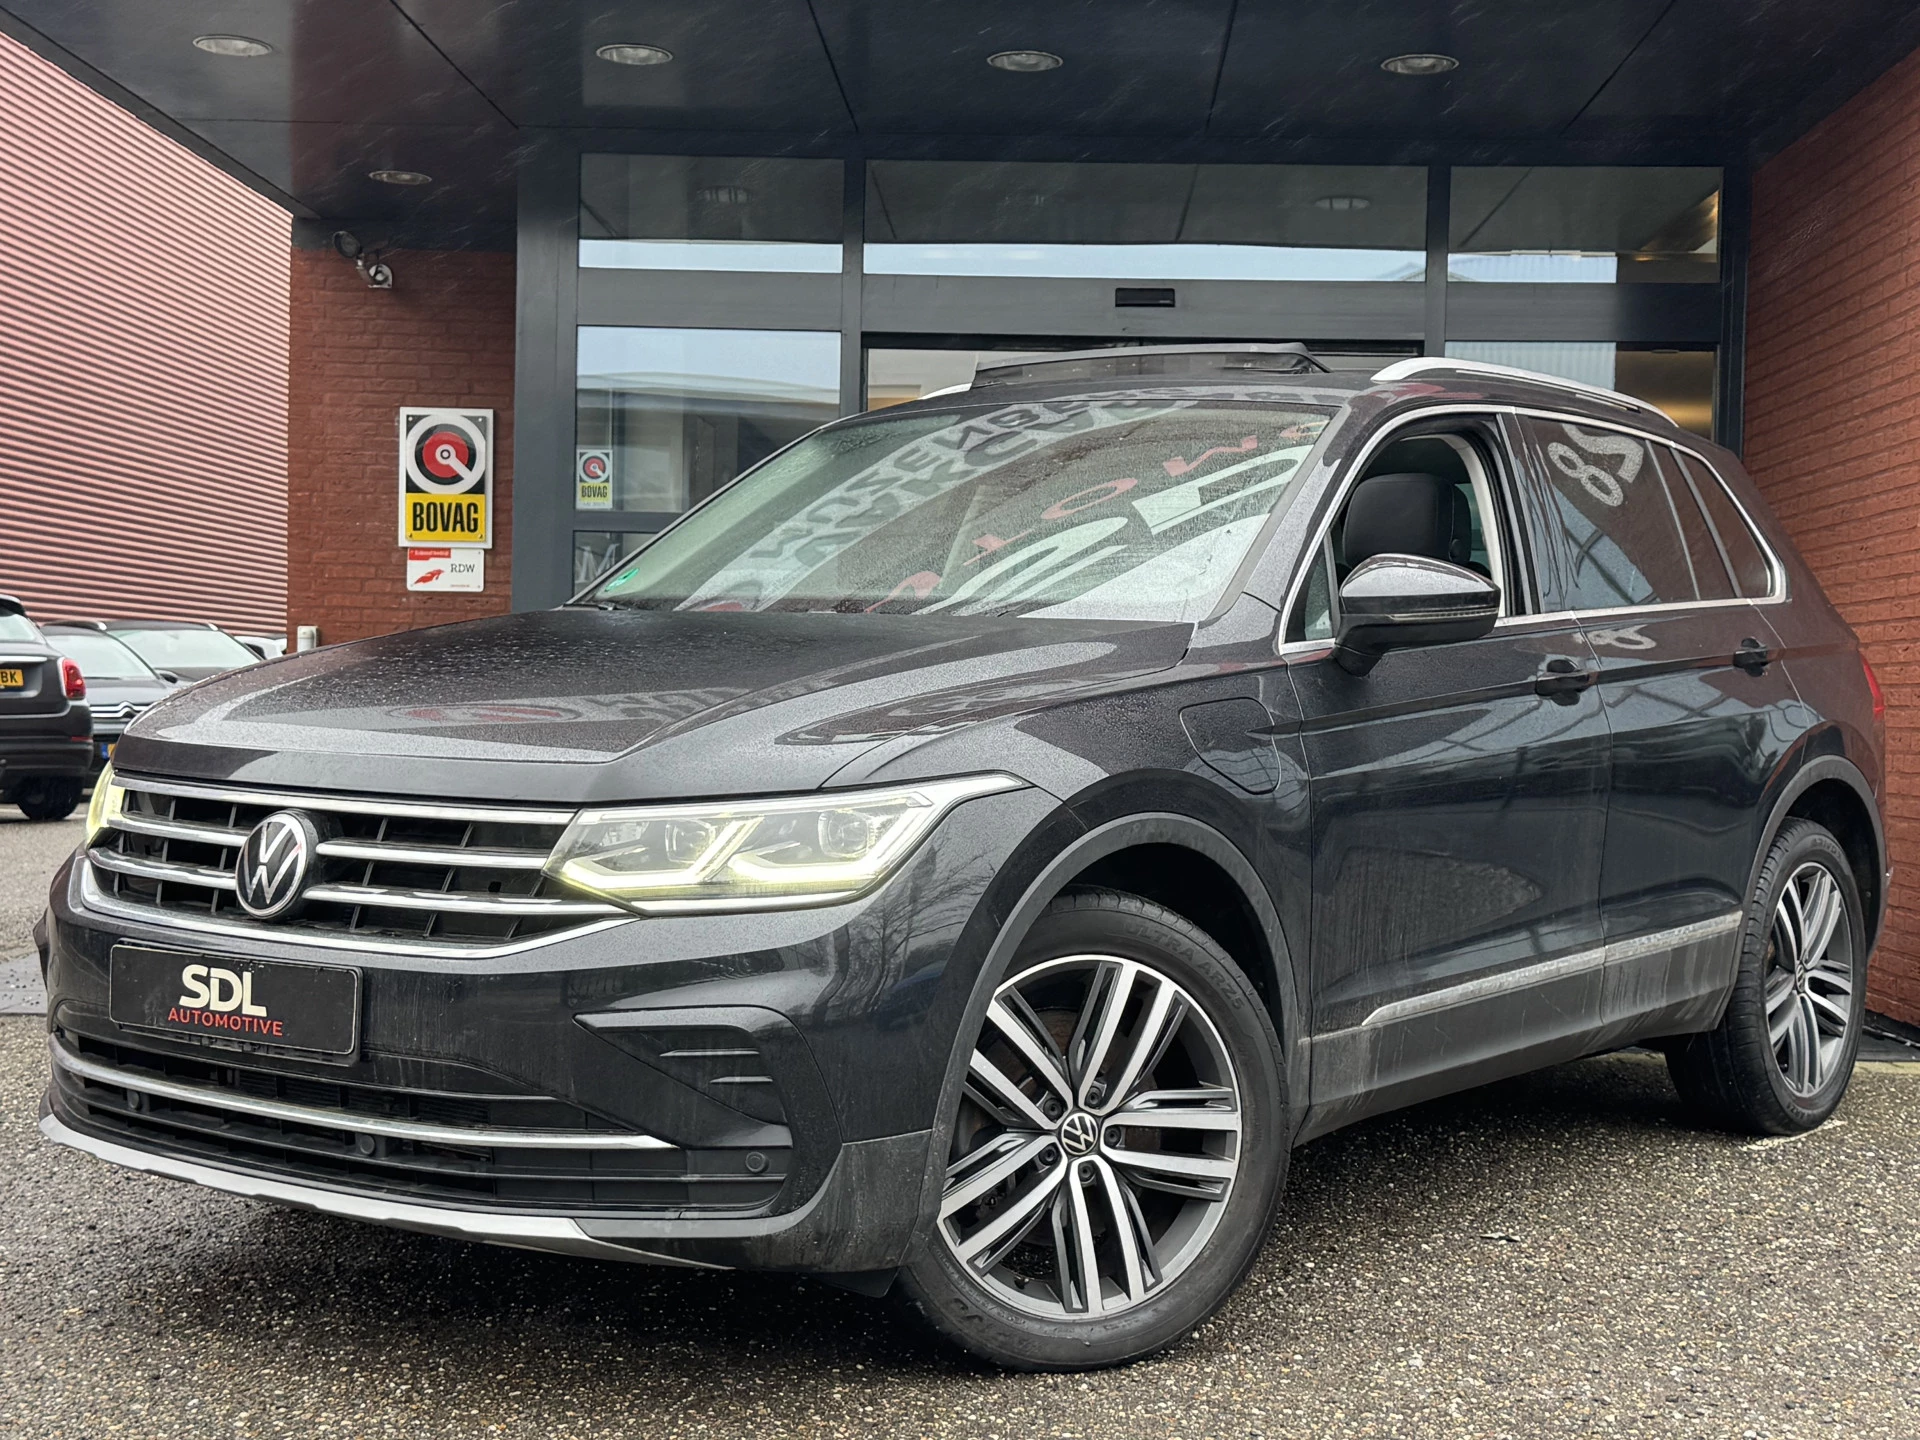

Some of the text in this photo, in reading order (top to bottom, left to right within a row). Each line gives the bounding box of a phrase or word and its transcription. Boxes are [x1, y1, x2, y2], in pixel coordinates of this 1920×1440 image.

[581, 485, 608, 498] BOVAG
[412, 501, 479, 532] BOVAG
[450, 563, 476, 573] RDW
[178, 964, 268, 1017] SDL
[168, 1007, 284, 1037] AUTOMOTIVE
